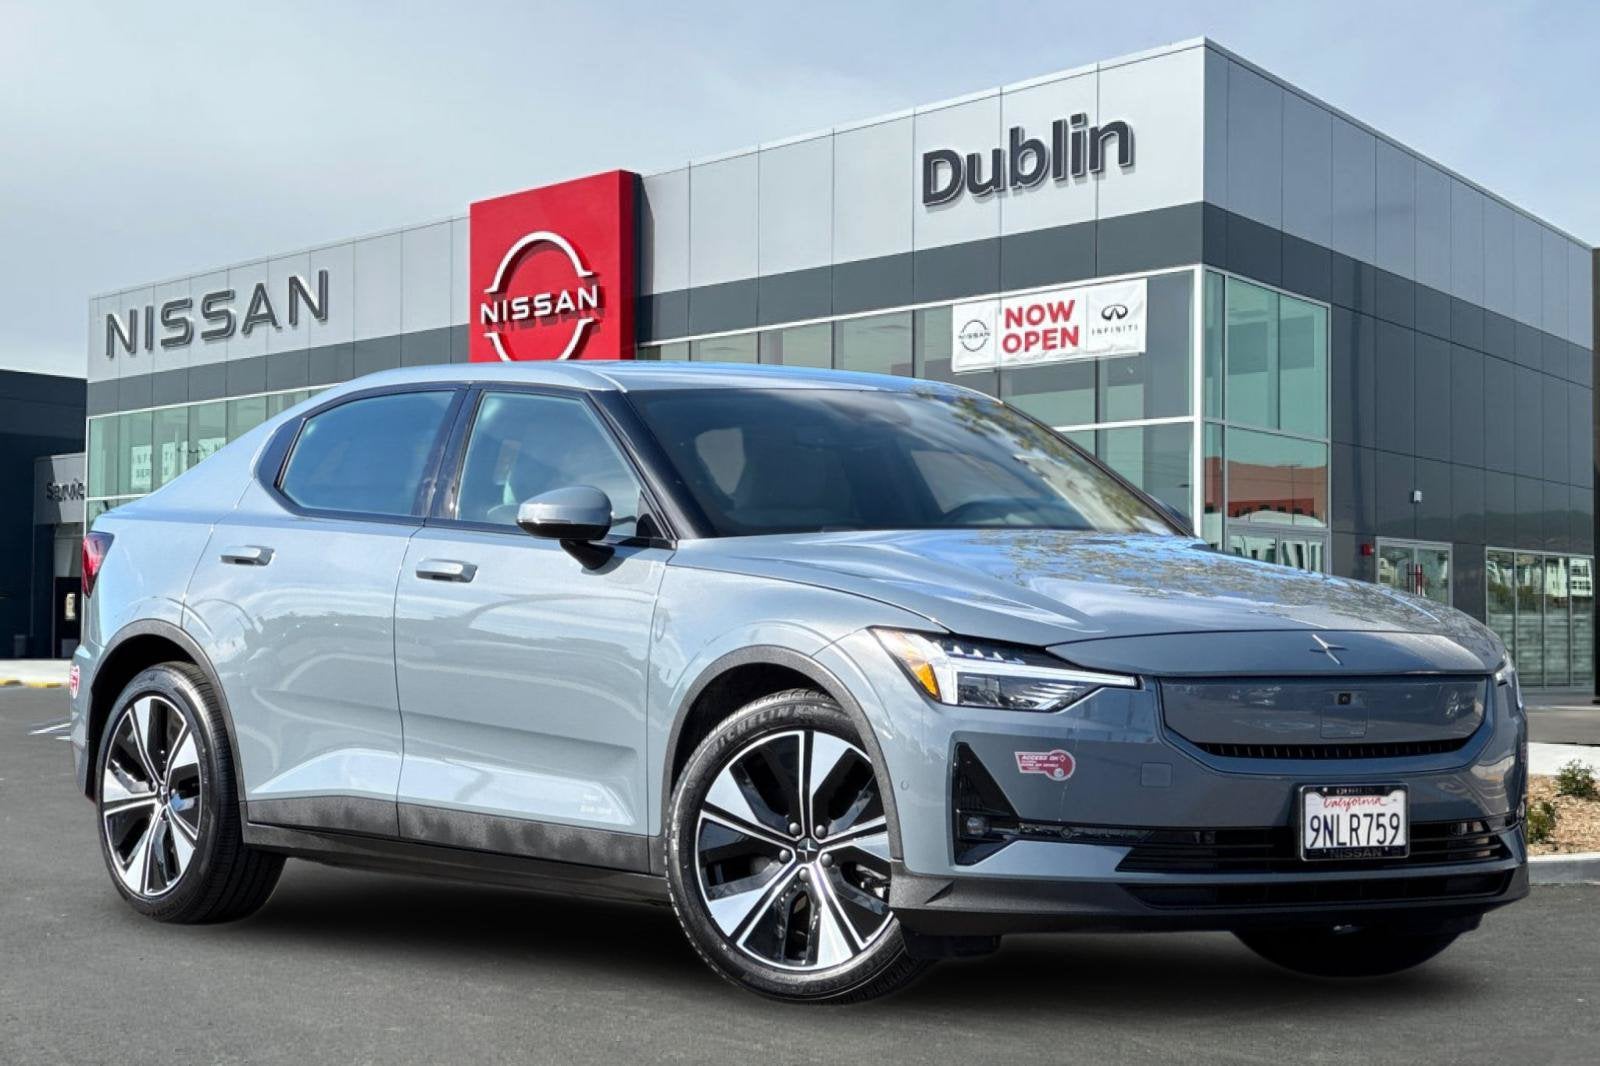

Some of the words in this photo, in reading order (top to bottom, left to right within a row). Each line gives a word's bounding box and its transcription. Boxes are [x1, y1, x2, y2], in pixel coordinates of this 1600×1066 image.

[922, 112, 1134, 206] Dublin
[105, 269, 329, 358] NISSAN
[480, 284, 598, 325] NISSAN
[1005, 300, 1075, 329] NOW
[958, 331, 991, 340] NISSAN
[1002, 325, 1079, 354] OPEN
[1091, 323, 1139, 336] INFINITI
[46, 478, 85, 502] Servic
[1323, 796, 1388, 812] California
[1310, 813, 1400, 848] 9NLR759
[1330, 848, 1382, 859] NISSAN
